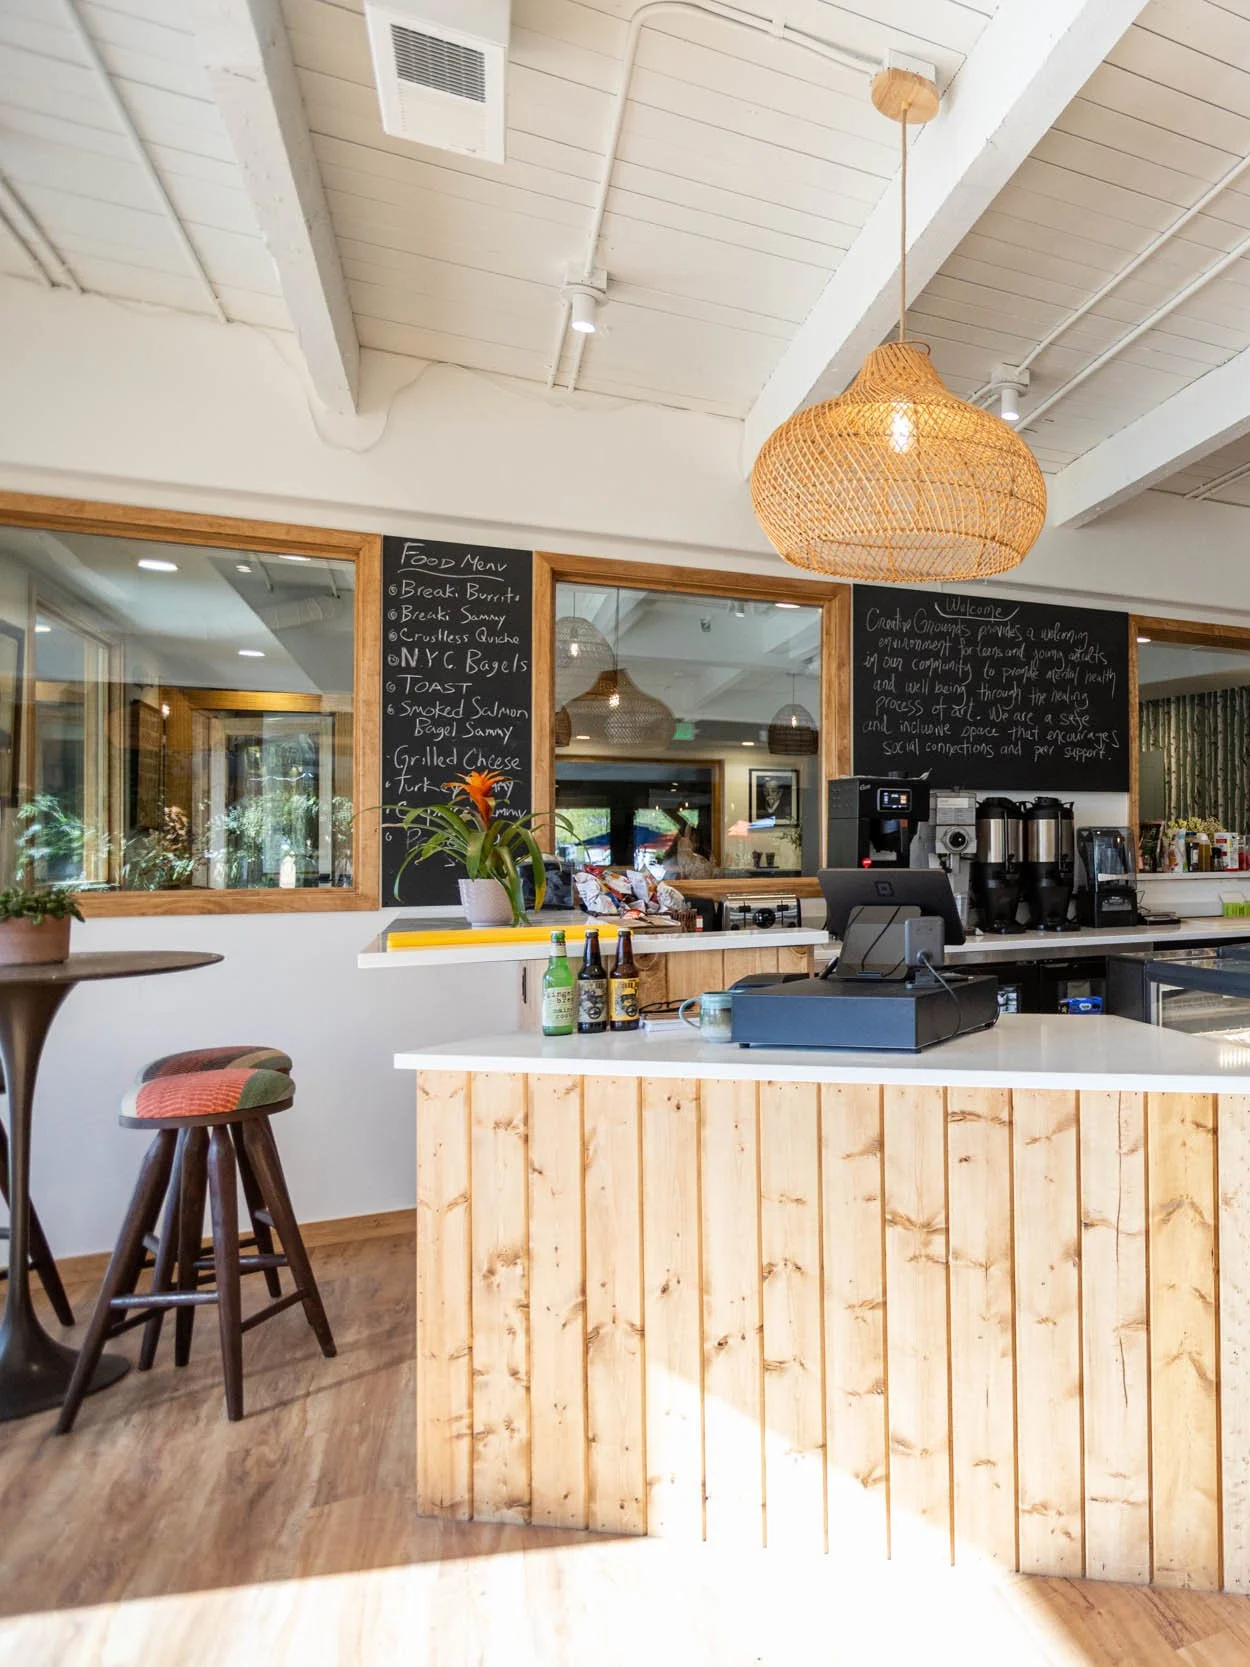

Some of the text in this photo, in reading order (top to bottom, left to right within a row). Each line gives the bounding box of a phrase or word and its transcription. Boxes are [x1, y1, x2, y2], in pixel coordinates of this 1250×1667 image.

[460, 553, 508, 572] Menu
[460, 604, 506, 631] Sammy
[945, 597, 1004, 622] Welcome
[400, 626, 520, 645] Crustless Quiche
[866, 607, 1088, 652] Creative Grounds provides a welcoming
[466, 648, 529, 678] Bagels
[878, 635, 1107, 671] environment for teens and young adults
[396, 674, 473, 695] TOAST
[863, 651, 878, 675] in
[881, 656, 903, 671] our
[911, 658, 972, 685] community
[984, 660, 996, 679] to
[1046, 663, 1079, 686] mental
[1085, 668, 1117, 699] health
[873, 673, 1089, 710] and well being through the healing
[399, 695, 529, 720] Smoked Salmon
[875, 695, 923, 717] process
[931, 696, 948, 720] of
[989, 704, 1009, 722] We
[1013, 711, 1034, 725] are
[1044, 712, 1054, 725] a
[1060, 709, 1090, 731] safe
[414, 717, 513, 745] Bagel Sammy
[862, 713, 1120, 749] and inclusive space that encourages
[394, 744, 523, 776] Grilled Cheese
[882, 738, 920, 757] social
[925, 739, 995, 758] connections
[1000, 740, 1022, 757] and
[1034, 745, 1056, 762] peer
